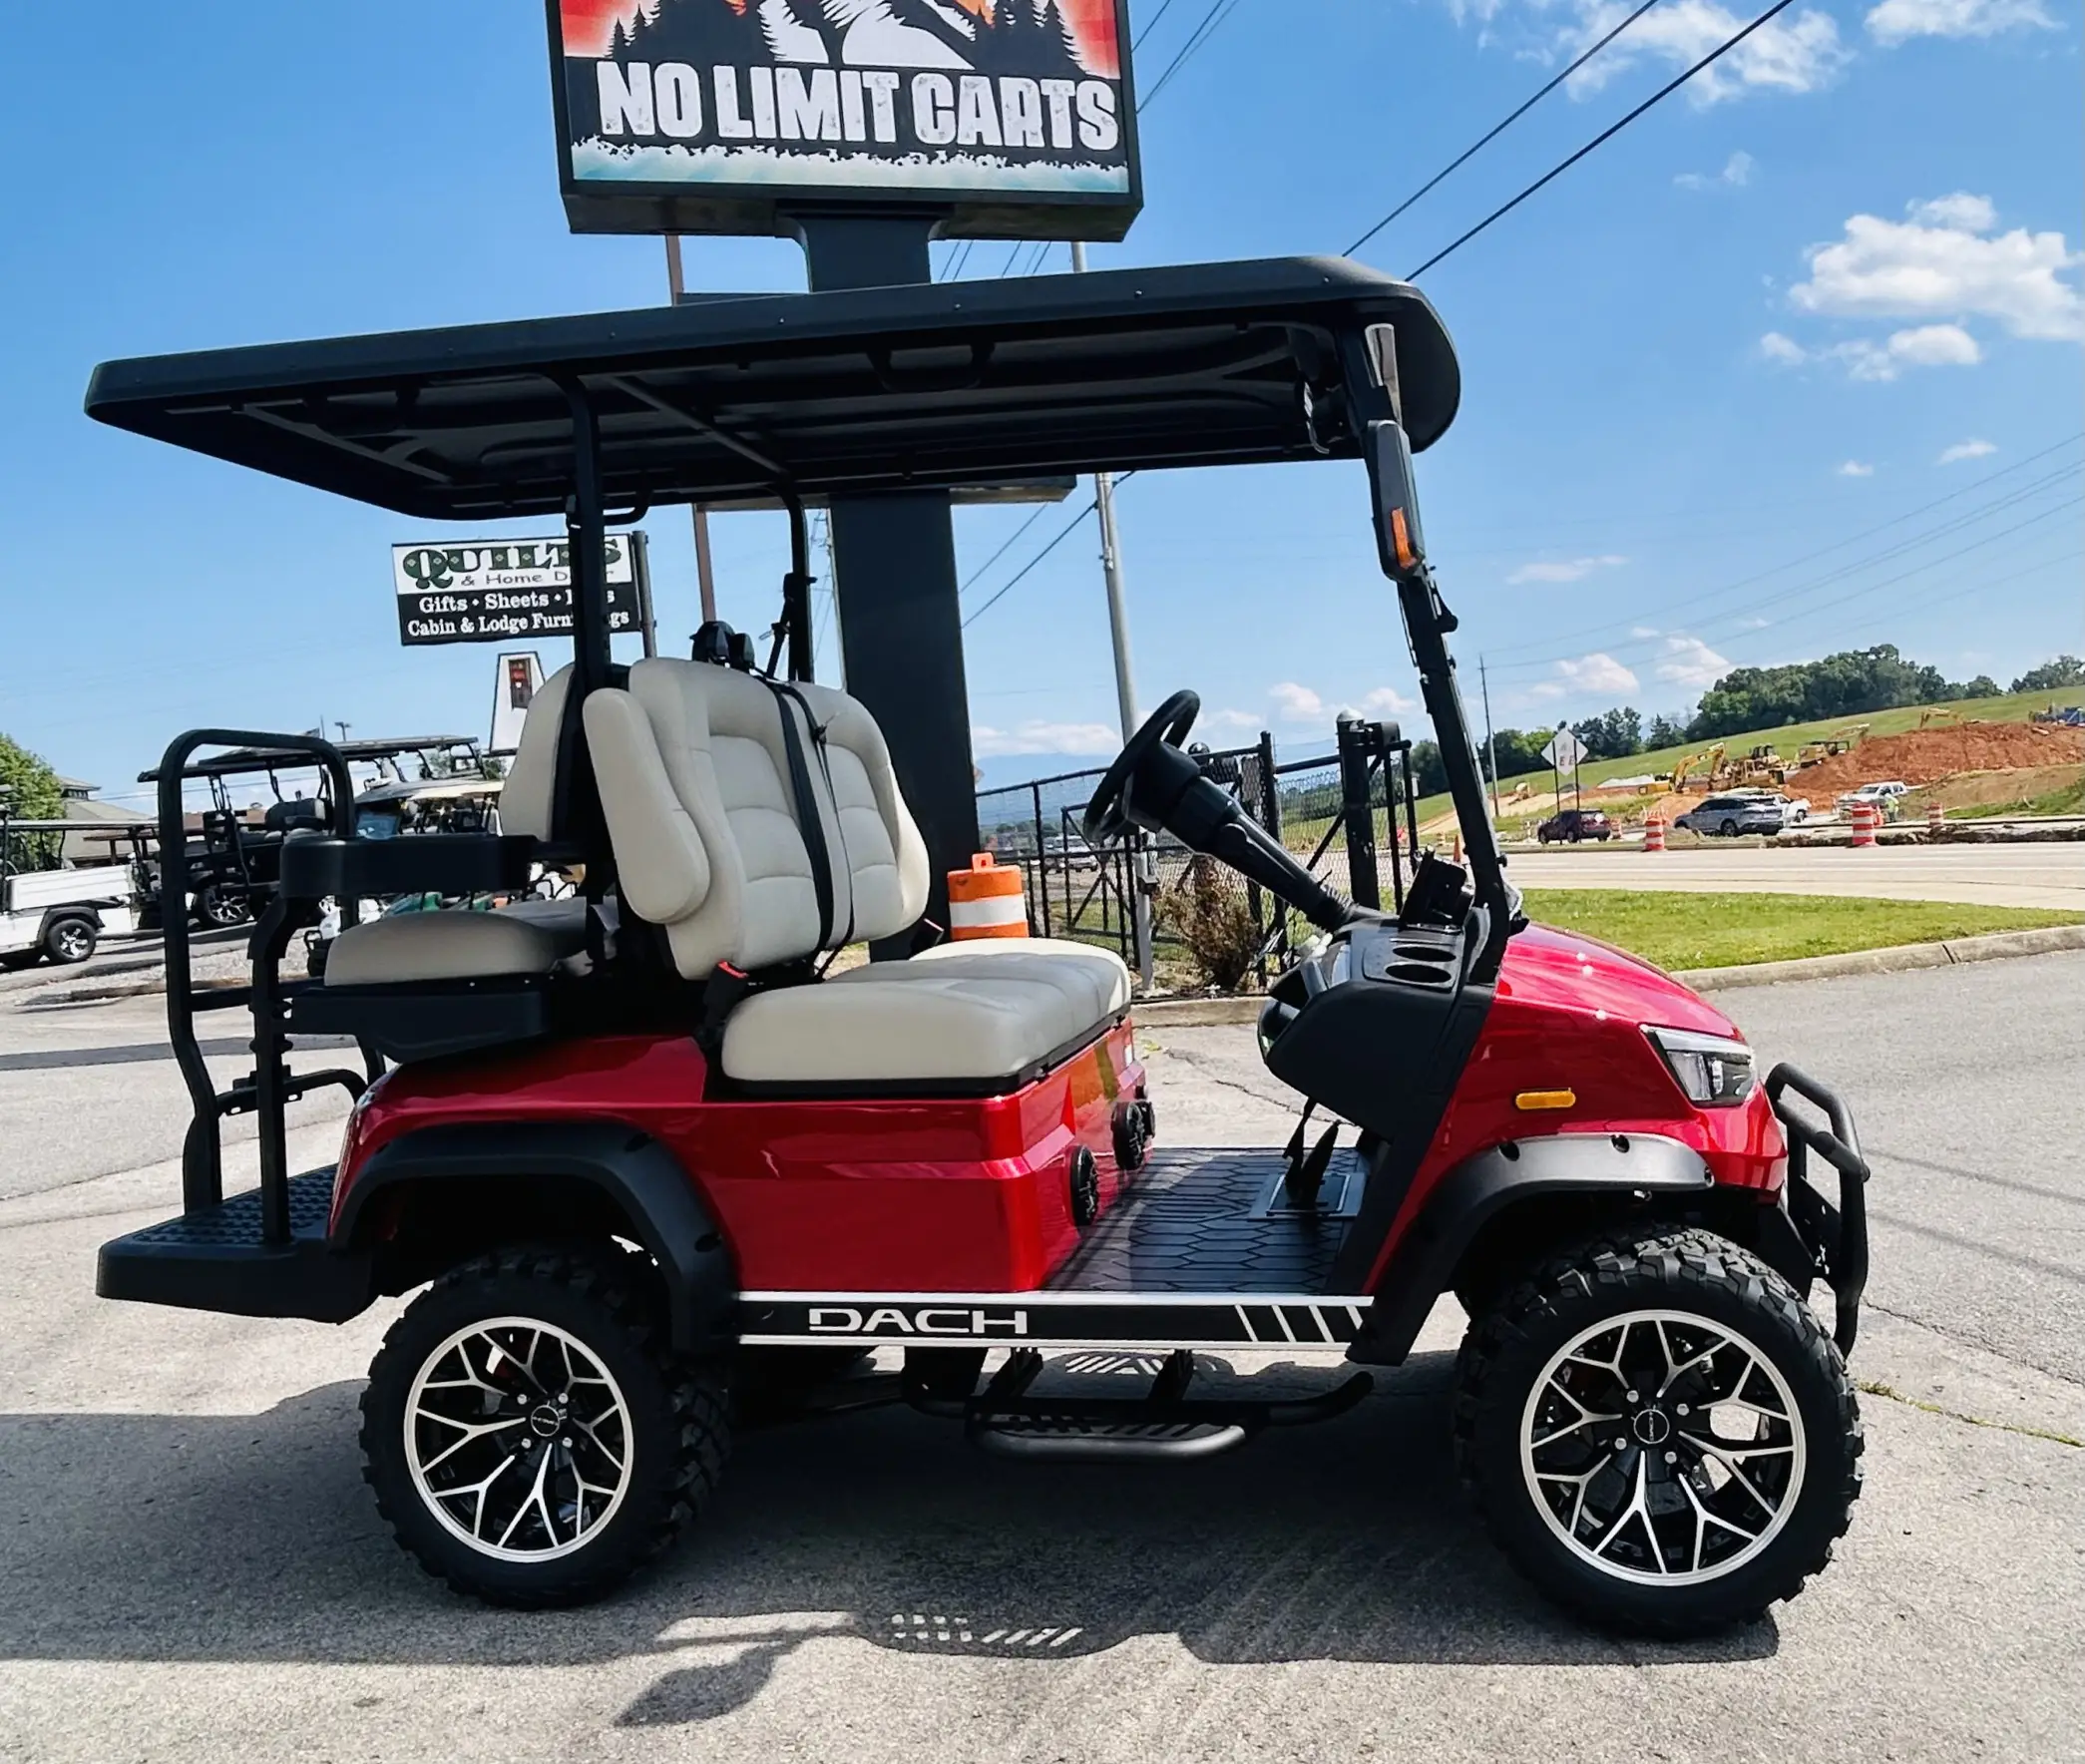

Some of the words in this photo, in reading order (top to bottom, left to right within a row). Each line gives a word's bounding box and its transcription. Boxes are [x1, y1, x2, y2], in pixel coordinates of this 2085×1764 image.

[596, 61, 700, 137] NO
[711, 65, 900, 143] LIMIT
[911, 73, 1119, 151] CARTS
[461, 576, 475, 586] &
[486, 573, 543, 585] Home
[419, 597, 468, 614] Gifts
[485, 592, 549, 610] Sheets
[408, 619, 457, 637] Cabin
[460, 618, 475, 633] &
[479, 614, 528, 635] Lodge
[533, 610, 628, 629] Furngs
[808, 1308, 1028, 1334] DACH
